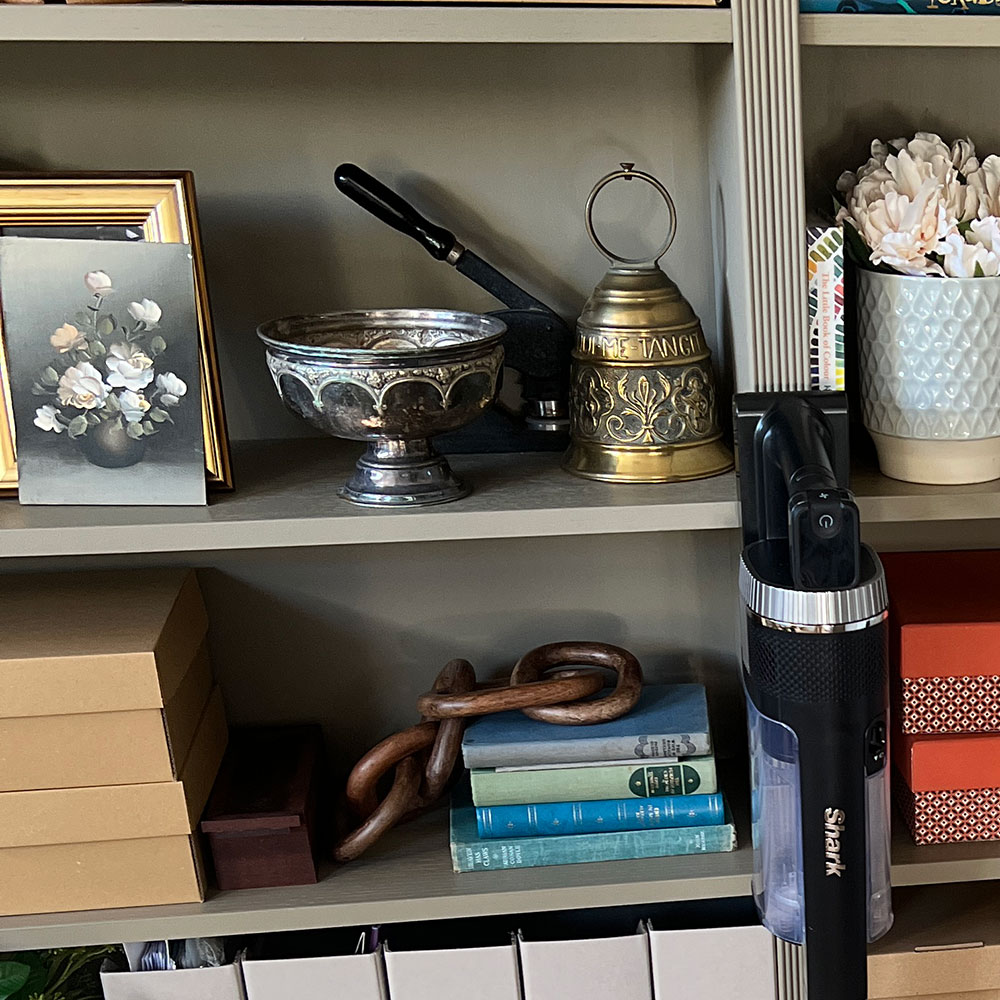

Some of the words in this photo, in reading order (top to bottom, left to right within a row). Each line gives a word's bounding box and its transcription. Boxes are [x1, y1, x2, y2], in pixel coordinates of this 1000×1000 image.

[822, 272, 830, 289] The
[822, 290, 831, 313] Little
[822, 317, 831, 338] Book
[823, 342, 832, 351] of
[823, 352, 832, 380] Colour
[824, 807, 847, 878] Shark
[481, 847, 490, 867] CLAWS
